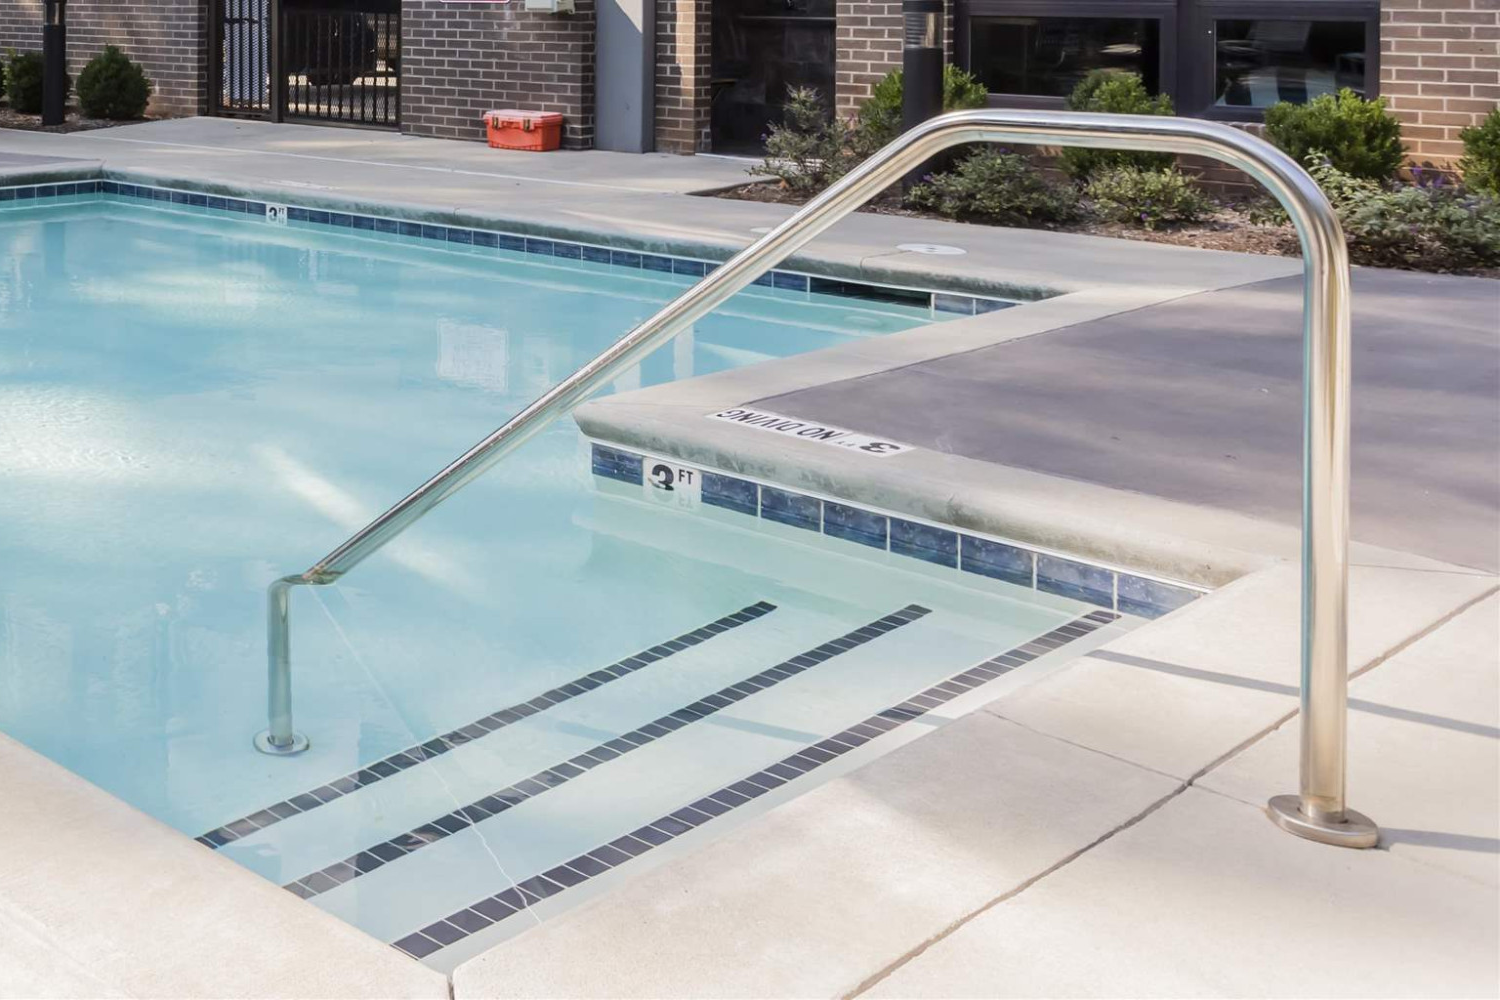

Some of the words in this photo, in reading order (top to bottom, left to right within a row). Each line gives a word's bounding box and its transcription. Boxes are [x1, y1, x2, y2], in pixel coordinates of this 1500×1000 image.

[716, 409, 804, 432] DIVING
[797, 427, 844, 440] NO
[859, 442, 901, 453] 3
[651, 464, 675, 491] 3
[678, 469, 694, 485] FT
